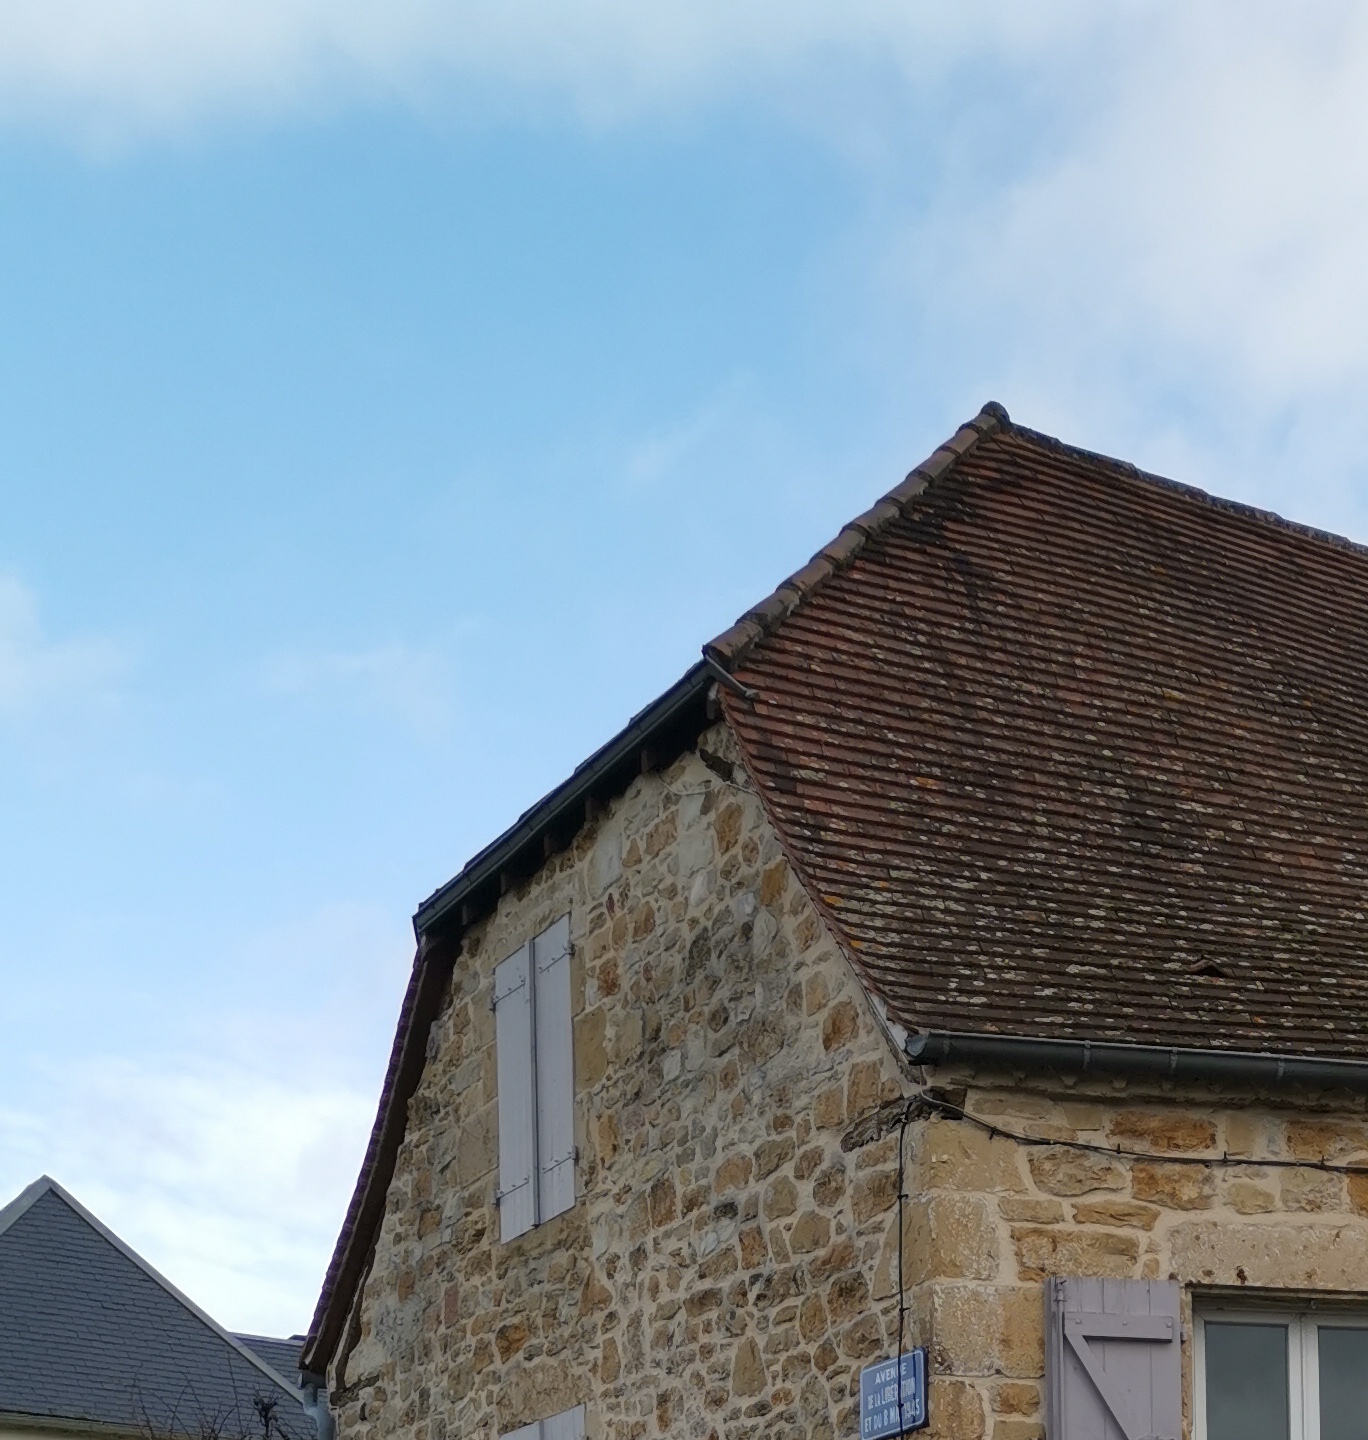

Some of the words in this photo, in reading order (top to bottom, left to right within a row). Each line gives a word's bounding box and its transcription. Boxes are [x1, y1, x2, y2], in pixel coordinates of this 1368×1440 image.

[874, 1362, 907, 1386] AVENE
[881, 1377, 916, 1404] LIBÉRTION
[864, 1416, 872, 1433] ET
[873, 1412, 882, 1430] DU
[883, 1408, 888, 1427] 8
[889, 1406, 901, 1424] MA
